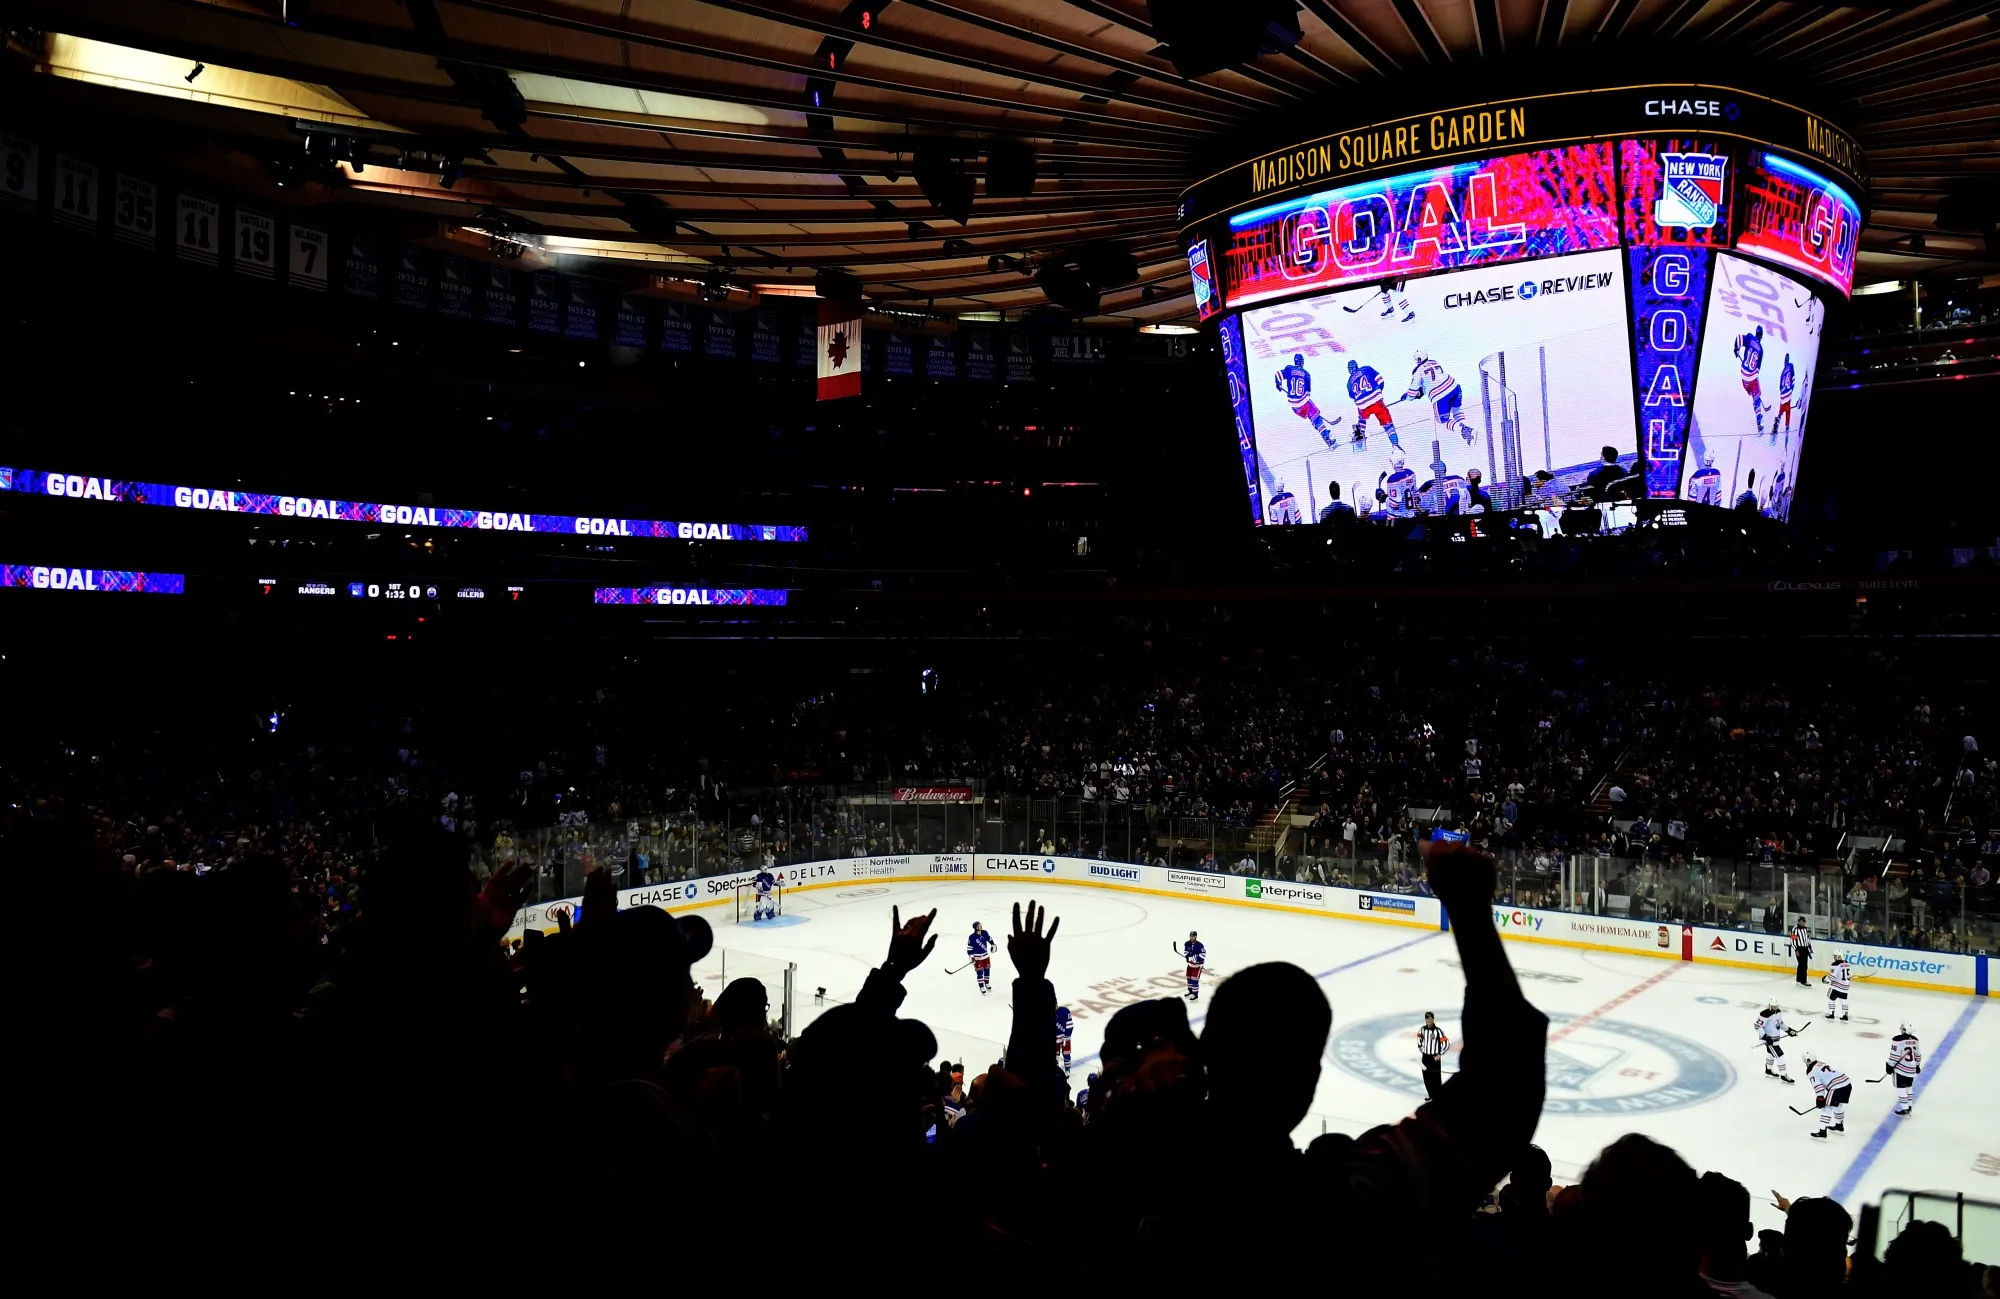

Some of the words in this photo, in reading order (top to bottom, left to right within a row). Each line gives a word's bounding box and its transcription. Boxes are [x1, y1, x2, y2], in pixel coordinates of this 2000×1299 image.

[1644, 99, 1721, 117] CHASE
[1252, 144, 1331, 193] MADISON
[1339, 124, 1421, 169] SQUARE
[1430, 107, 1525, 151] GARDEN
[6, 153, 24, 191] 9
[1669, 162, 1694, 175] NEW
[1698, 163, 1721, 177] YORK
[62, 174, 90, 215] 11
[1677, 179, 1713, 223] RANGERS
[118, 191, 153, 232] 35
[185, 211, 210, 249] 11
[1279, 172, 1526, 280] GOAL
[241, 227, 269, 262] 19
[301, 241, 317, 274] 7
[485, 290, 516, 303] 1993-94
[1444, 285, 1515, 309] CHASE
[1540, 271, 1613, 296] REVIEW
[530, 298, 558, 310] 1926-27
[567, 304, 596, 317] 1931-32
[617, 311, 646, 324] 1941-42
[663, 318, 692, 331] 1989-90
[709, 325, 737, 337] 1991-92
[1051, 335, 1070, 347] BILLY
[1164, 336, 1187, 359] 13
[886, 345, 912, 355] 2011-12
[929, 350, 955, 358] 2013-14
[967, 352, 994, 361] 2014-15
[1053, 346, 1070, 358] JOEL
[1290, 377, 1305, 396] 16
[47, 472, 118, 501] GOAL
[175, 486, 240, 511] GOAL
[279, 496, 341, 520] GOAL
[380, 504, 442, 526] GOAL
[477, 511, 536, 531] GOAL
[575, 516, 631, 537] GOAL
[678, 521, 734, 540] GOAL
[33, 566, 99, 591] GOAL
[1787, 581, 1842, 590] LEXUS
[1859, 580, 1889, 590] SUITE
[1889, 579, 1921, 589] LEVEL
[263, 585, 271, 595] 7
[298, 586, 336, 596] RANGERS
[367, 583, 380, 598] 0
[385, 590, 405, 599] 1:32
[409, 585, 420, 599] 0
[457, 590, 485, 599] OILERS
[511, 592, 520, 602] 7
[657, 588, 713, 605] GOAL
[898, 787, 968, 801] Budweiser
[869, 856, 910, 866] Northwell
[929, 863, 943, 873] LIVE
[944, 863, 968, 873] GAMES
[986, 858, 1039, 871] CHASE
[789, 864, 836, 880] DELTA
[869, 866, 896, 875] Health
[1090, 865, 1111, 877] BUD
[1111, 867, 1139, 880] LIGHT
[1171, 873, 1202, 883] EMPIRE
[630, 886, 682, 907] CHASE
[1249, 884, 1323, 900] enterprise
[550, 905, 571, 919] KA
[1570, 921, 1595, 932] RAO'S
[1596, 924, 1651, 939] HOMEMADE
[1735, 938, 1792, 958] DELT
[1844, 950, 1945, 974] icketmaster
